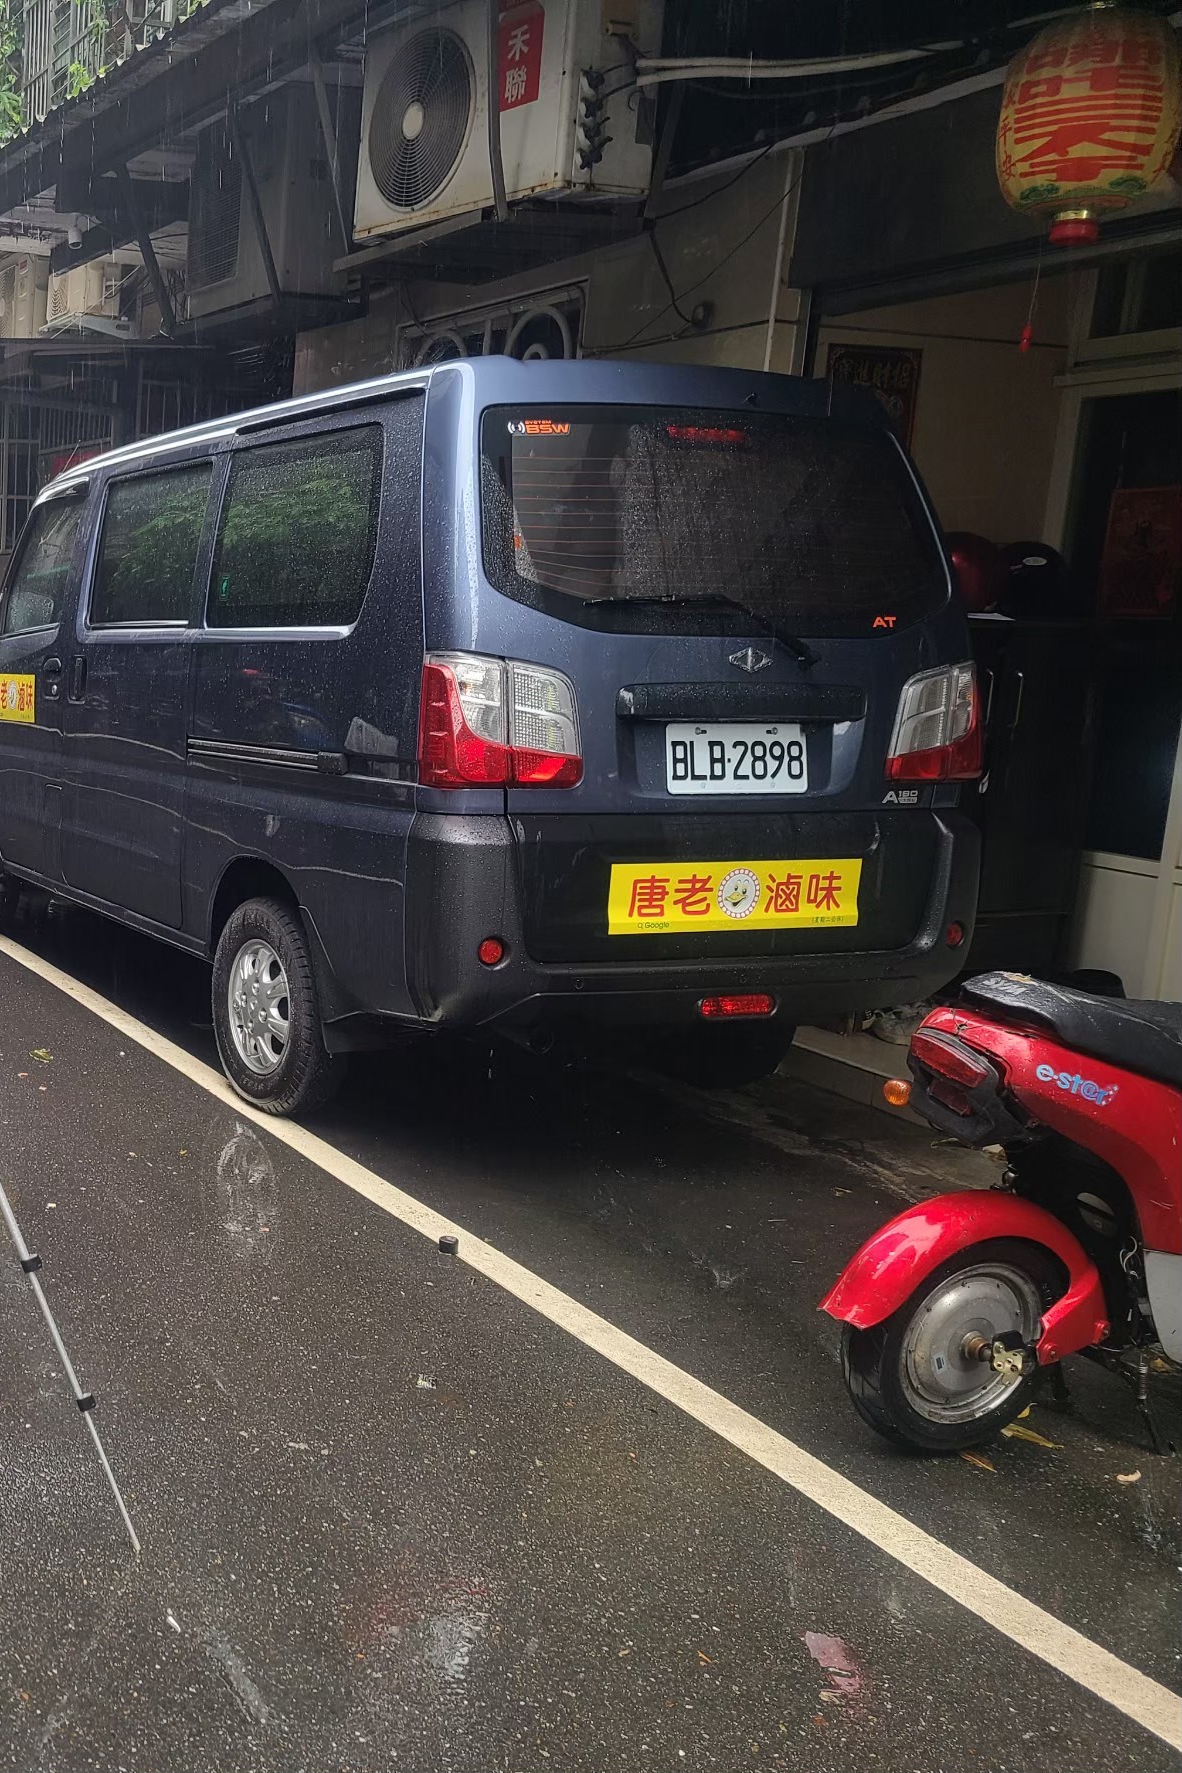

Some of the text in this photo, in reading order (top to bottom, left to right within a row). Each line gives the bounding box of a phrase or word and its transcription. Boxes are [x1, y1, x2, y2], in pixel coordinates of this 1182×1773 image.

[504, 24, 531, 103] 禾聯
[525, 423, 569, 434] BSW
[872, 616, 897, 628] AT
[627, 871, 842, 918] 唐老 滷味
[644, 921, 670, 930] Google
